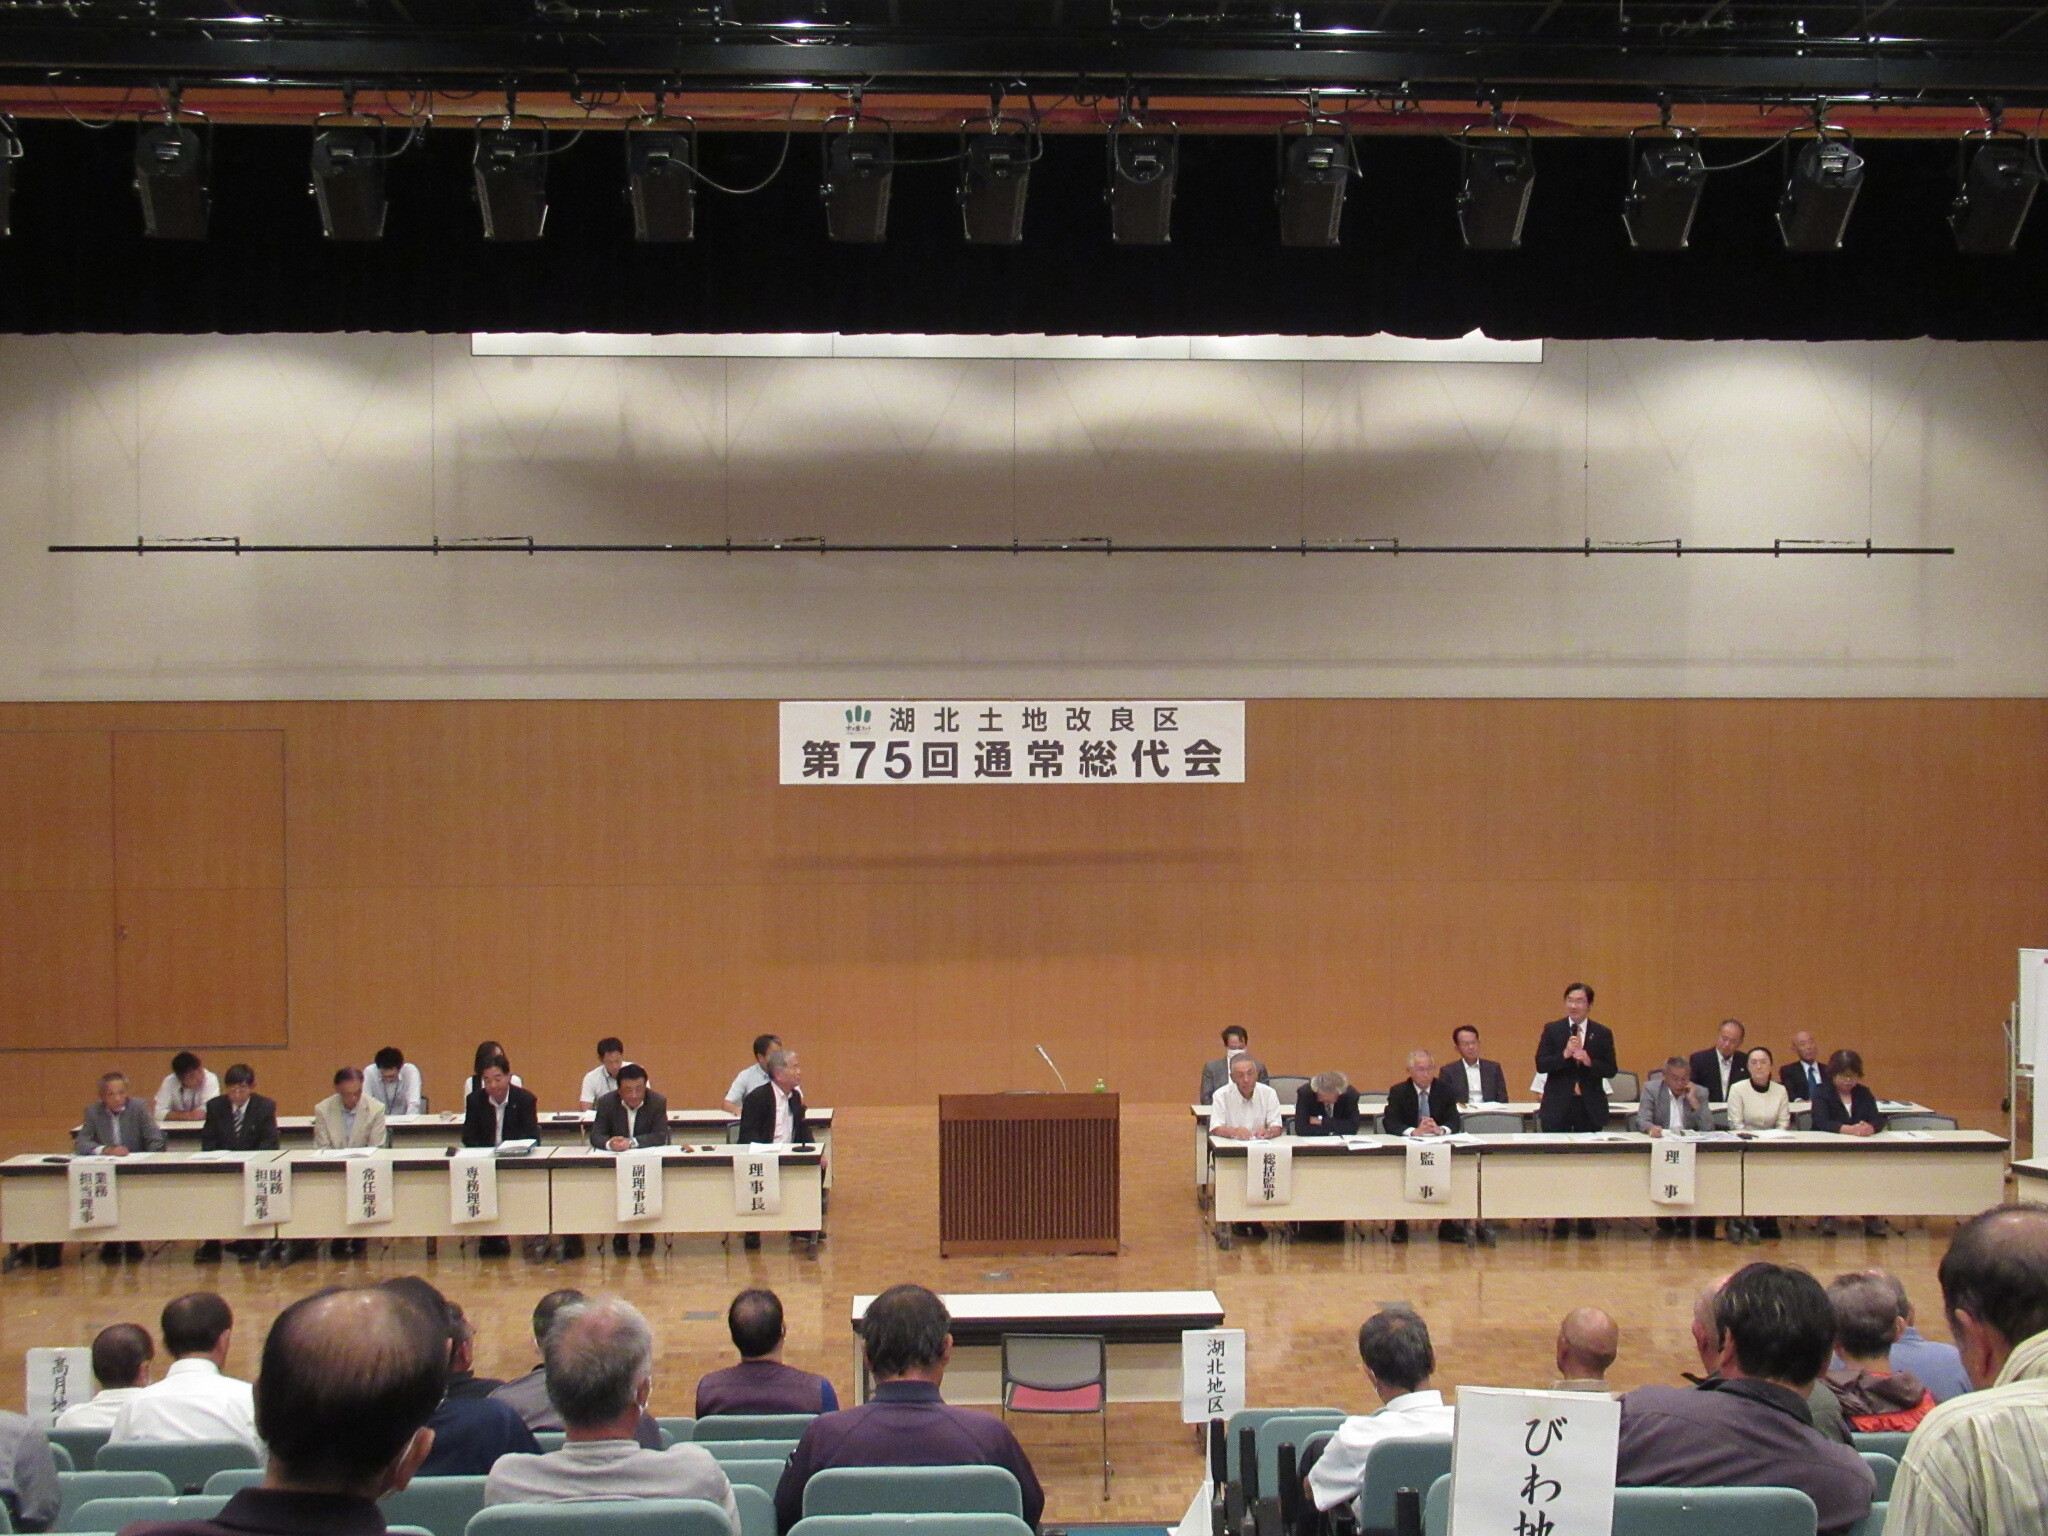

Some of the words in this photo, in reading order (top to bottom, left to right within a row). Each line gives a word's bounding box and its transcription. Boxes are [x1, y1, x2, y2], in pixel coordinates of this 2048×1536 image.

[890, 706, 1179, 733] 湖北土地改良区
[802, 738, 1223, 779] 第75回通常総代会
[362, 1168, 376, 1218] 常任理事
[466, 1166, 481, 1218] 専務理事
[632, 1164, 646, 1216] 副理事長
[748, 1162, 766, 1211] 理事長
[1206, 1338, 1226, 1414] 湖北地区
